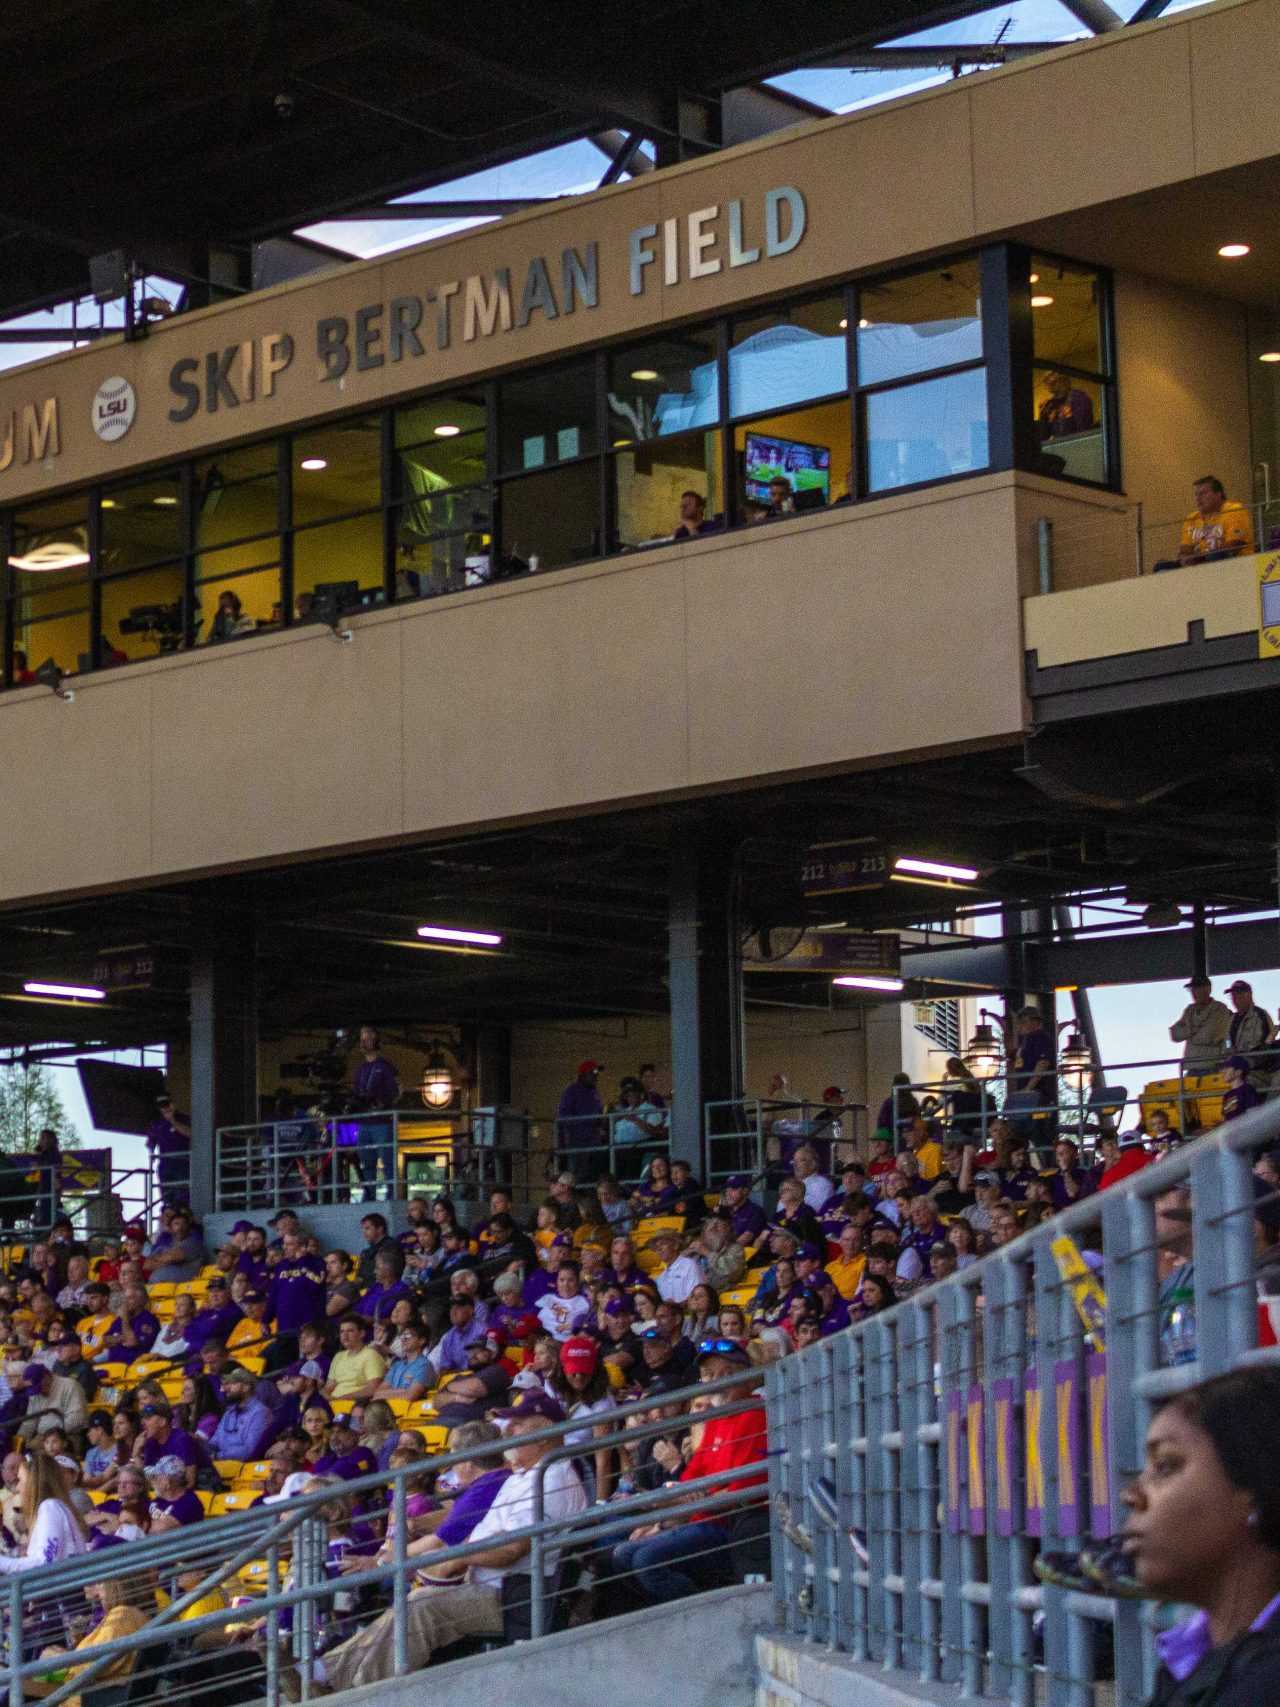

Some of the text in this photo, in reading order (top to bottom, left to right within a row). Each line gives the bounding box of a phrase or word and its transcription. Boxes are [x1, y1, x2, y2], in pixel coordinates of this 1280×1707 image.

[167, 185, 808, 424] SKIP BERTMAN FIELD
[97, 397, 129, 420] LSU
[862, 857, 886, 872] 213
